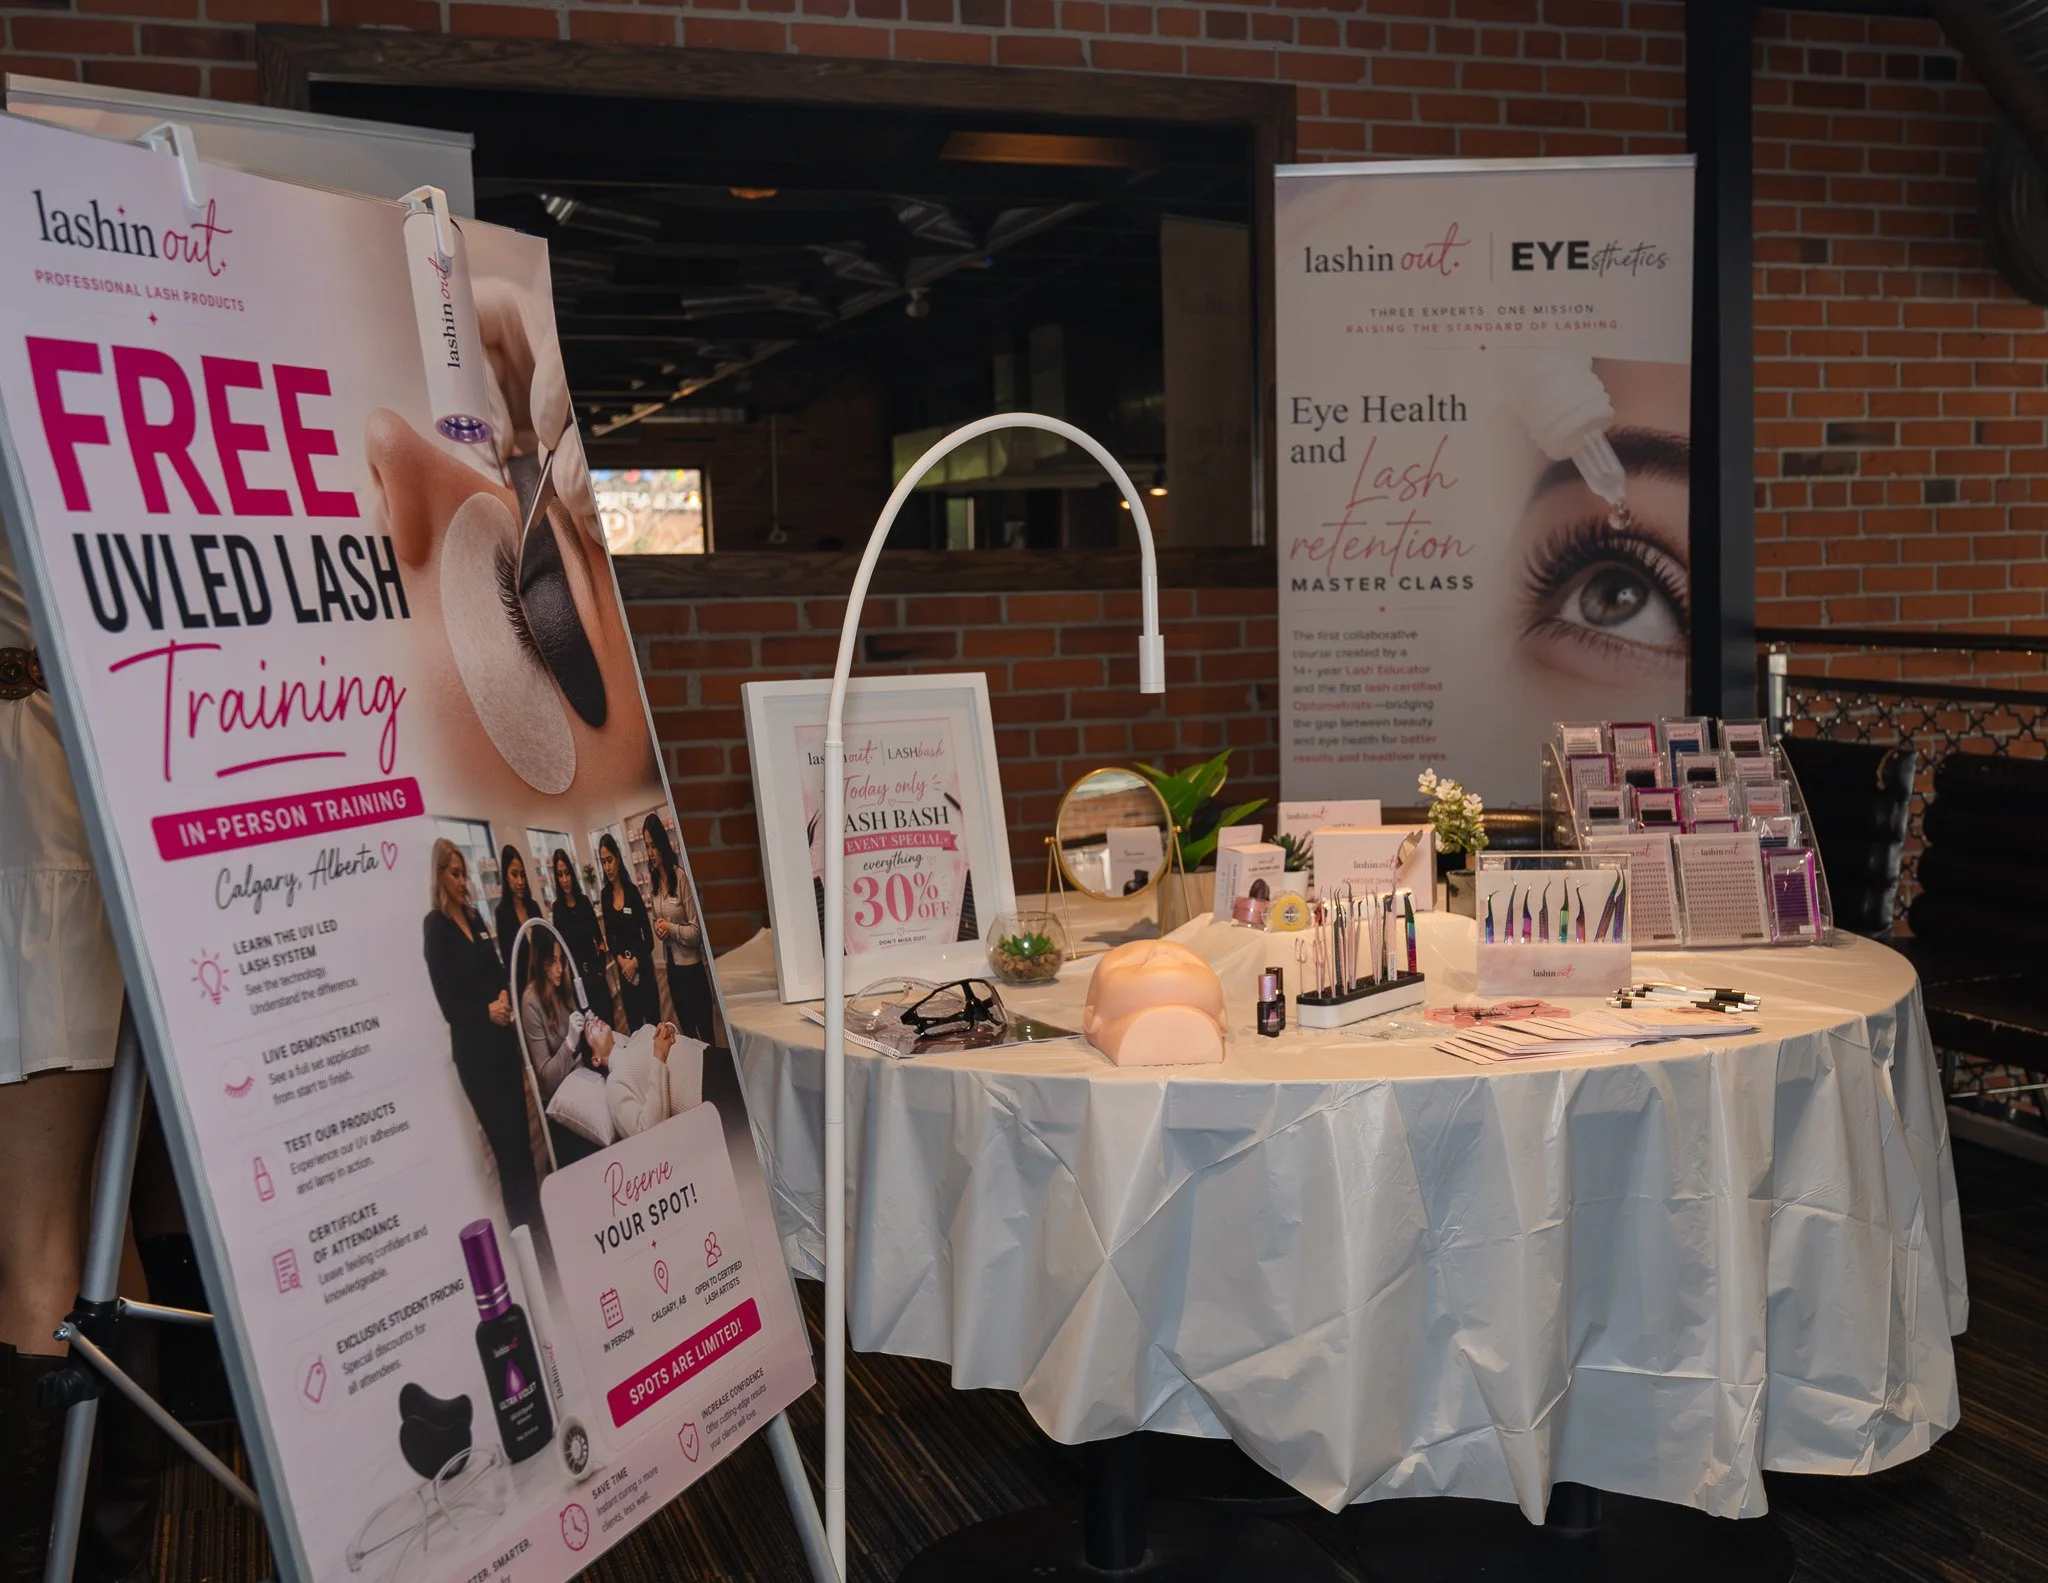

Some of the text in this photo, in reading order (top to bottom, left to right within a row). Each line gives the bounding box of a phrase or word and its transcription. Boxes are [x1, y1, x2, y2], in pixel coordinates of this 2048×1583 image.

[32, 190, 159, 258] lashin
[1304, 245, 1395, 274] lashin
[1511, 240, 1670, 278] EYEsthetics
[35, 269, 246, 312] PROFESSIONAL LASH PRODUCTS
[1345, 323, 1406, 335] RAISING
[1413, 322, 1440, 334] THE
[1446, 321, 1524, 333] STANDARD
[1530, 321, 1550, 332] OF
[1369, 303, 1599, 319] THREE EXPERTS. ONE MISSION.
[441, 302, 461, 369] lashin
[24, 334, 361, 519] FREE
[1290, 394, 1469, 431] Eye Health
[1290, 434, 1459, 511] and Lash
[1289, 509, 1476, 578] retention
[71, 531, 412, 633] UVLED LASH
[1291, 575, 1475, 593] MASTER CLASS
[108, 638, 408, 784] Training
[894, 771, 929, 801] only
[178, 787, 408, 848] IN-PERSON TRAINING
[844, 805, 950, 834] ASH BASH
[845, 834, 944, 853] EVENT SPECIAL
[862, 850, 924, 873] everything
[214, 842, 380, 915] Calgary, Alberta
[917, 900, 951, 920] OFF
[233, 918, 339, 956] LEARN THE UV LED
[238, 944, 318, 976] LASH SYSTEM
[245, 977, 279, 996] See the
[261, 1016, 381, 1065] LIVE DEMONSTRATION
[268, 1071, 287, 1086] See
[283, 1101, 397, 1154] TEST OUR PRODUCTS
[604, 1159, 674, 1218] Reserve
[308, 1201, 380, 1244] CERTIFICATE
[594, 1182, 699, 1256] YOUR SPOT!
[312, 1214, 402, 1266] OF ATTENDANCE
[695, 1259, 743, 1296] OPEN TO CERTIFIED
[704, 1276, 741, 1306] LASH ARTISTS
[335, 1278, 466, 1355] EXCLUSIVE STUDENT PRICING
[651, 1294, 688, 1324] CALGARY, AB
[603, 1325, 636, 1353] IN PERSON
[628, 1316, 744, 1406] SPOTS ARE LIMITED!
[701, 1366, 765, 1420] INCREASE CONFIDENCE
[591, 1466, 629, 1500] SAVE TIME
